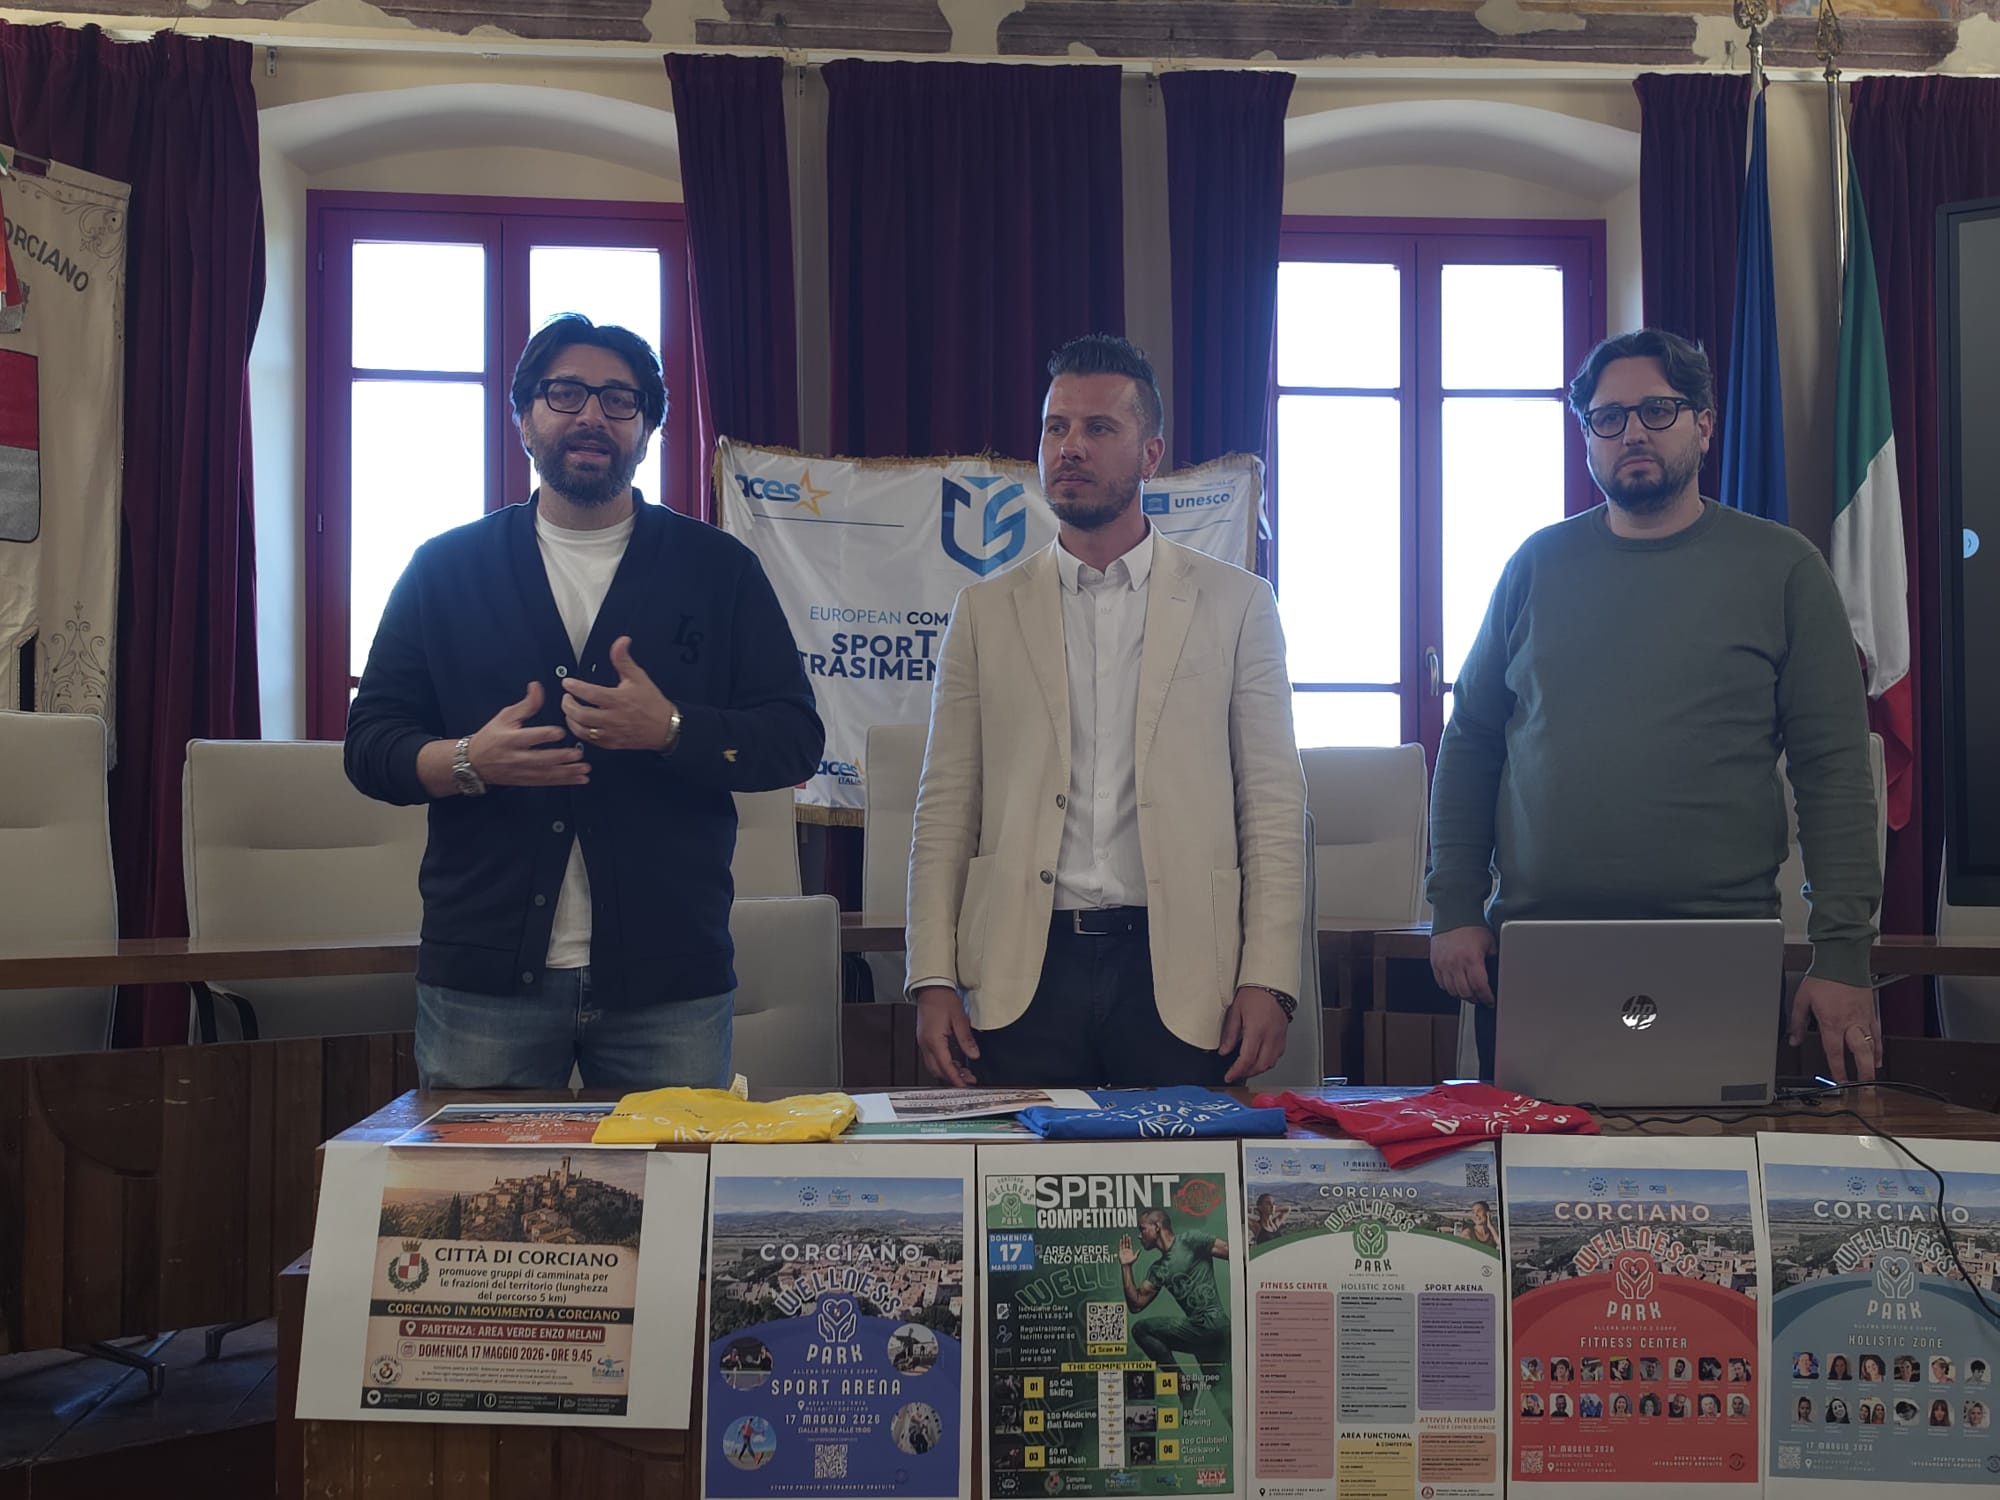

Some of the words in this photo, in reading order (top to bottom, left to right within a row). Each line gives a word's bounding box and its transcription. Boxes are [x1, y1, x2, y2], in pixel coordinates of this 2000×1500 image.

[1175, 493, 1230, 508] unesco
[810, 606, 900, 624] EUROPEAN
[907, 612, 951, 626] COM
[832, 630, 937, 658] SPORT
[988, 1183, 1034, 1201] WELLNESS
[1035, 1174, 1180, 1209] SPRINT
[1319, 1186, 1417, 1198] CORCIANO
[1037, 1208, 1138, 1229] COMPETITION
[1324, 1198, 1416, 1232] WELLNESS
[1554, 1202, 1710, 1222] CORCIANO
[1813, 1201, 1969, 1223] CORCIANO
[435, 1246, 487, 1262] CITTÀ
[494, 1251, 511, 1263] DI
[519, 1251, 618, 1267] CORCIANO
[760, 1243, 921, 1262] CORCIANO
[1000, 1244, 1023, 1262] 17
[1045, 1246, 1072, 1254] AREA
[1075, 1245, 1109, 1254] VERDE
[1572, 1226, 1697, 1274] WELLNESS
[1833, 1226, 1955, 1275] WELLNESS
[1355, 1258, 1391, 1272] PARK
[439, 1268, 487, 1278] promuove
[491, 1269, 521, 1279] gruppi
[525, 1270, 534, 1279] di
[537, 1271, 590, 1281] camminata
[593, 1273, 608, 1282] per
[440, 1279, 449, 1287] le
[452, 1280, 489, 1289] frazioni
[492, 1281, 506, 1289] del
[509, 1282, 552, 1291] territorio
[556, 1282, 608, 1293] (lunghezza
[775, 1267, 902, 1315] WELLNESS
[1260, 1282, 1293, 1290] FITNESS
[1455, 1284, 1483, 1292] ARENA
[478, 1292, 492, 1300] del
[496, 1294, 536, 1302] percorso
[549, 1294, 566, 1303] km)
[388, 1304, 450, 1314] CORCIANO
[455, 1305, 468, 1315] IN
[471, 1306, 543, 1318] MOVIMENTO
[546, 1308, 555, 1318] A
[558, 1309, 620, 1320] CORCIANO
[1606, 1301, 1661, 1321] PARK
[1867, 1300, 1922, 1320] PARK
[421, 1324, 475, 1336] PARTENZA:
[478, 1326, 503, 1337] AREA
[506, 1327, 536, 1338] VERDE
[540, 1328, 564, 1339] ENZO
[567, 1329, 601, 1340] MELANI
[1580, 1336, 1632, 1349] FITNESS
[1640, 1337, 1687, 1349] CENTER
[1849, 1335, 1905, 1347] HOLISTIC
[1913, 1336, 1943, 1348] ZONE
[419, 1344, 468, 1357] DOMENICA
[472, 1345, 480, 1357] 17
[483, 1346, 518, 1359] MAGGIO
[521, 1347, 544, 1360] 2026
[552, 1348, 569, 1361] ORE
[572, 1349, 592, 1362] 9.45
[807, 1344, 863, 1364] PARK
[771, 1379, 829, 1395] SPORT
[842, 1379, 901, 1395] ARENA
[1030, 1383, 1038, 1391] 01
[1163, 1379, 1171, 1388] 04
[786, 1415, 796, 1424] 17
[1164, 1415, 1173, 1423] 05
[1068, 1456, 1086, 1464] Push
[1198, 1471, 1225, 1479] WHY
